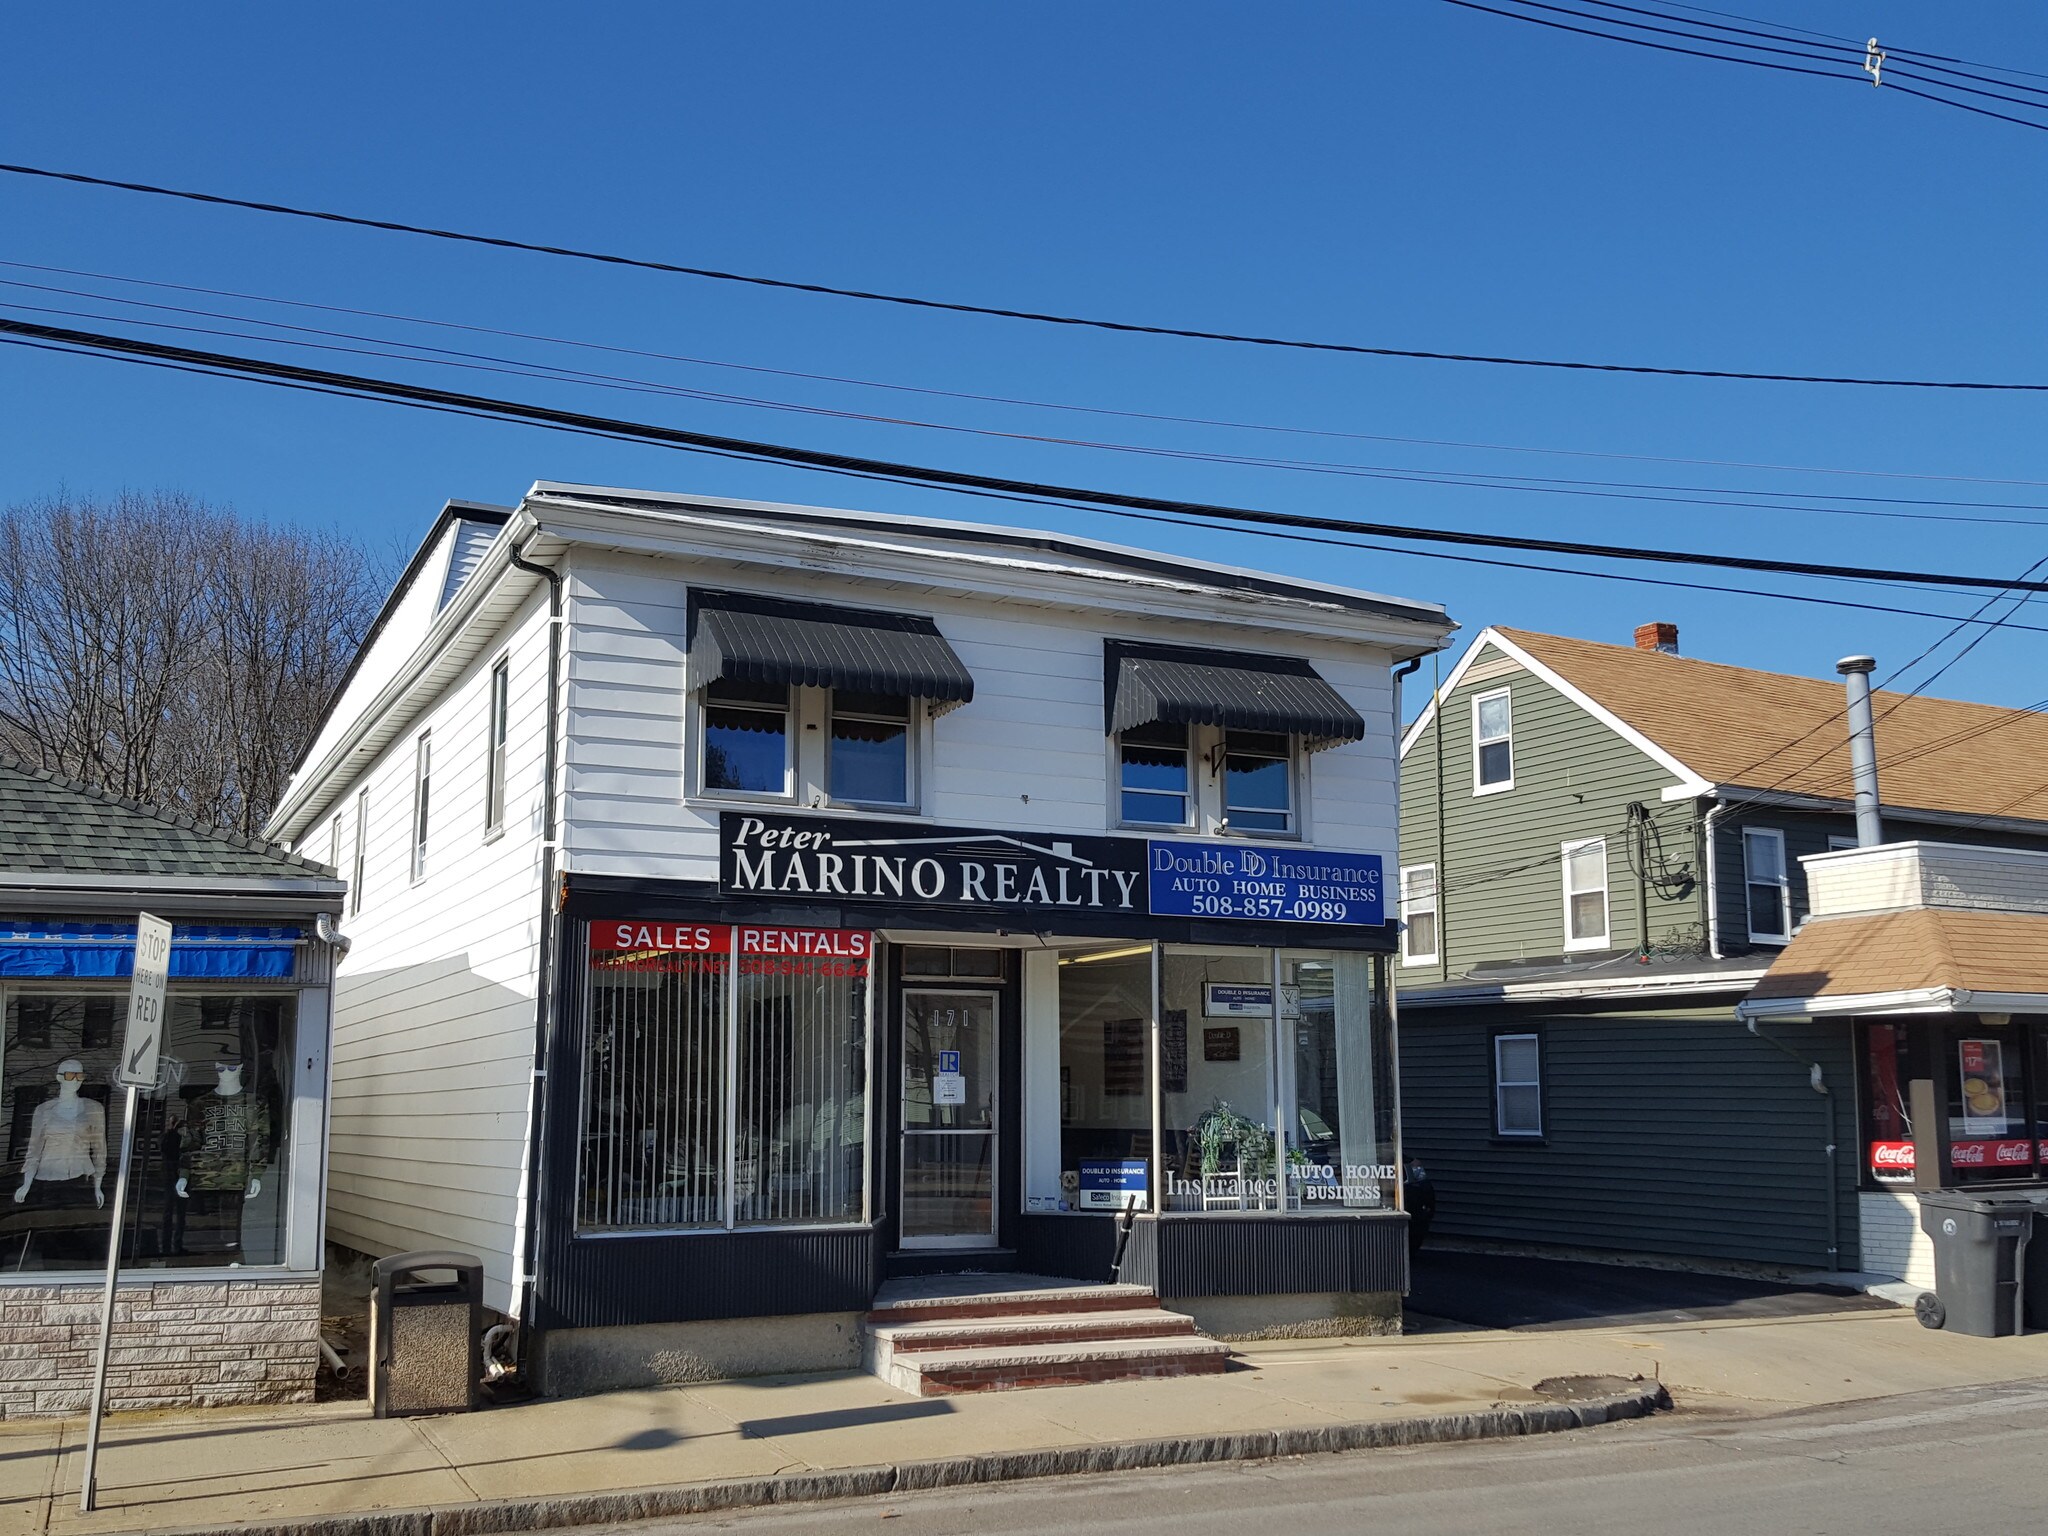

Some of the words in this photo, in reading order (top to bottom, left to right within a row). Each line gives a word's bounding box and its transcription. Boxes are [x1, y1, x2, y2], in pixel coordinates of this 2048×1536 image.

[732, 817, 831, 850] Peter
[731, 848, 945, 898] MARINO
[959, 862, 1140, 908] REALTY
[1153, 848, 1235, 875] Double
[1271, 855, 1380, 884] Insurance
[1171, 877, 1220, 893] AUTO
[1232, 880, 1287, 897] HOME
[1298, 884, 1377, 902] BUSINESS
[1191, 895, 1348, 921] 508-857-0989
[140, 931, 167, 962] STOP
[616, 924, 711, 950] SALES
[743, 929, 865, 955] RENTALS
[136, 967, 153, 986] HERE
[155, 973, 165, 990] ON
[740, 959, 870, 978] 508-941-6644
[1243, 989, 1271, 997] INSURANCE
[136, 994, 158, 1023] RED
[1082, 1167, 1105, 1175] DOUBLE
[1165, 1170, 1278, 1196] Insurance
[1290, 1165, 1335, 1180] AUTO
[1345, 1165, 1396, 1180] HOME
[1092, 1192, 1110, 1201] Safeco
[1306, 1185, 1381, 1200] BUSINESS
